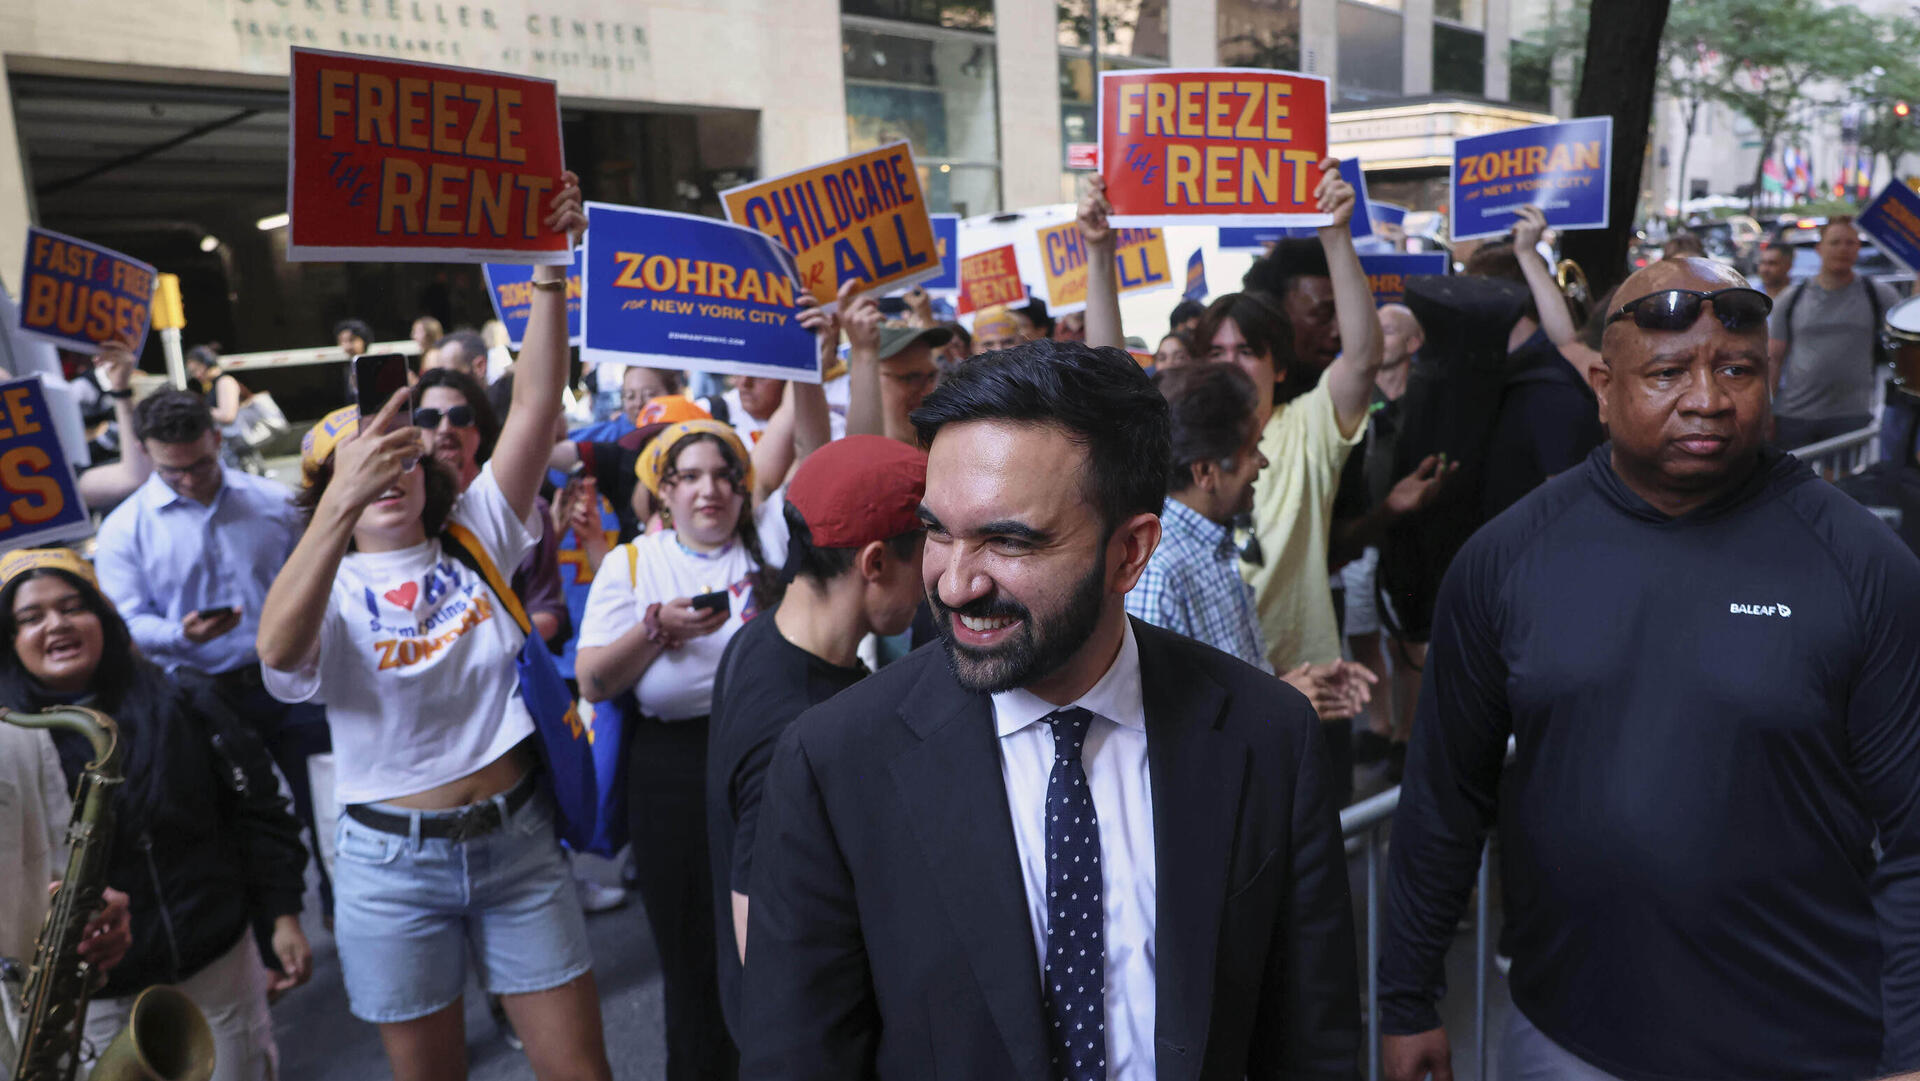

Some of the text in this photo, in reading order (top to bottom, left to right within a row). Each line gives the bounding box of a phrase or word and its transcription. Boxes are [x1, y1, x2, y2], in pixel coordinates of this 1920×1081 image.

[526, 14, 648, 46] CENTER
[318, 69, 527, 165] FREEZE
[1118, 81, 1292, 142] FREEZE
[1125, 143, 1160, 185] THE
[1165, 144, 1318, 206] RENT
[1459, 140, 1600, 186] ZOHRAN
[328, 152, 553, 239] THE RENT
[745, 154, 914, 257] CHILDCARE
[33, 235, 97, 281] FAST
[112, 260, 153, 300] FREE
[613, 252, 795, 308] ZOHRAN
[832, 213, 927, 290] ALL
[1116, 247, 1163, 288] LL
[26, 273, 146, 351] BUSES
[497, 274, 582, 308] ZOHN
[621, 299, 788, 326] FOR NEW YORK CITY
[1730, 603, 1777, 616] BALEAF
